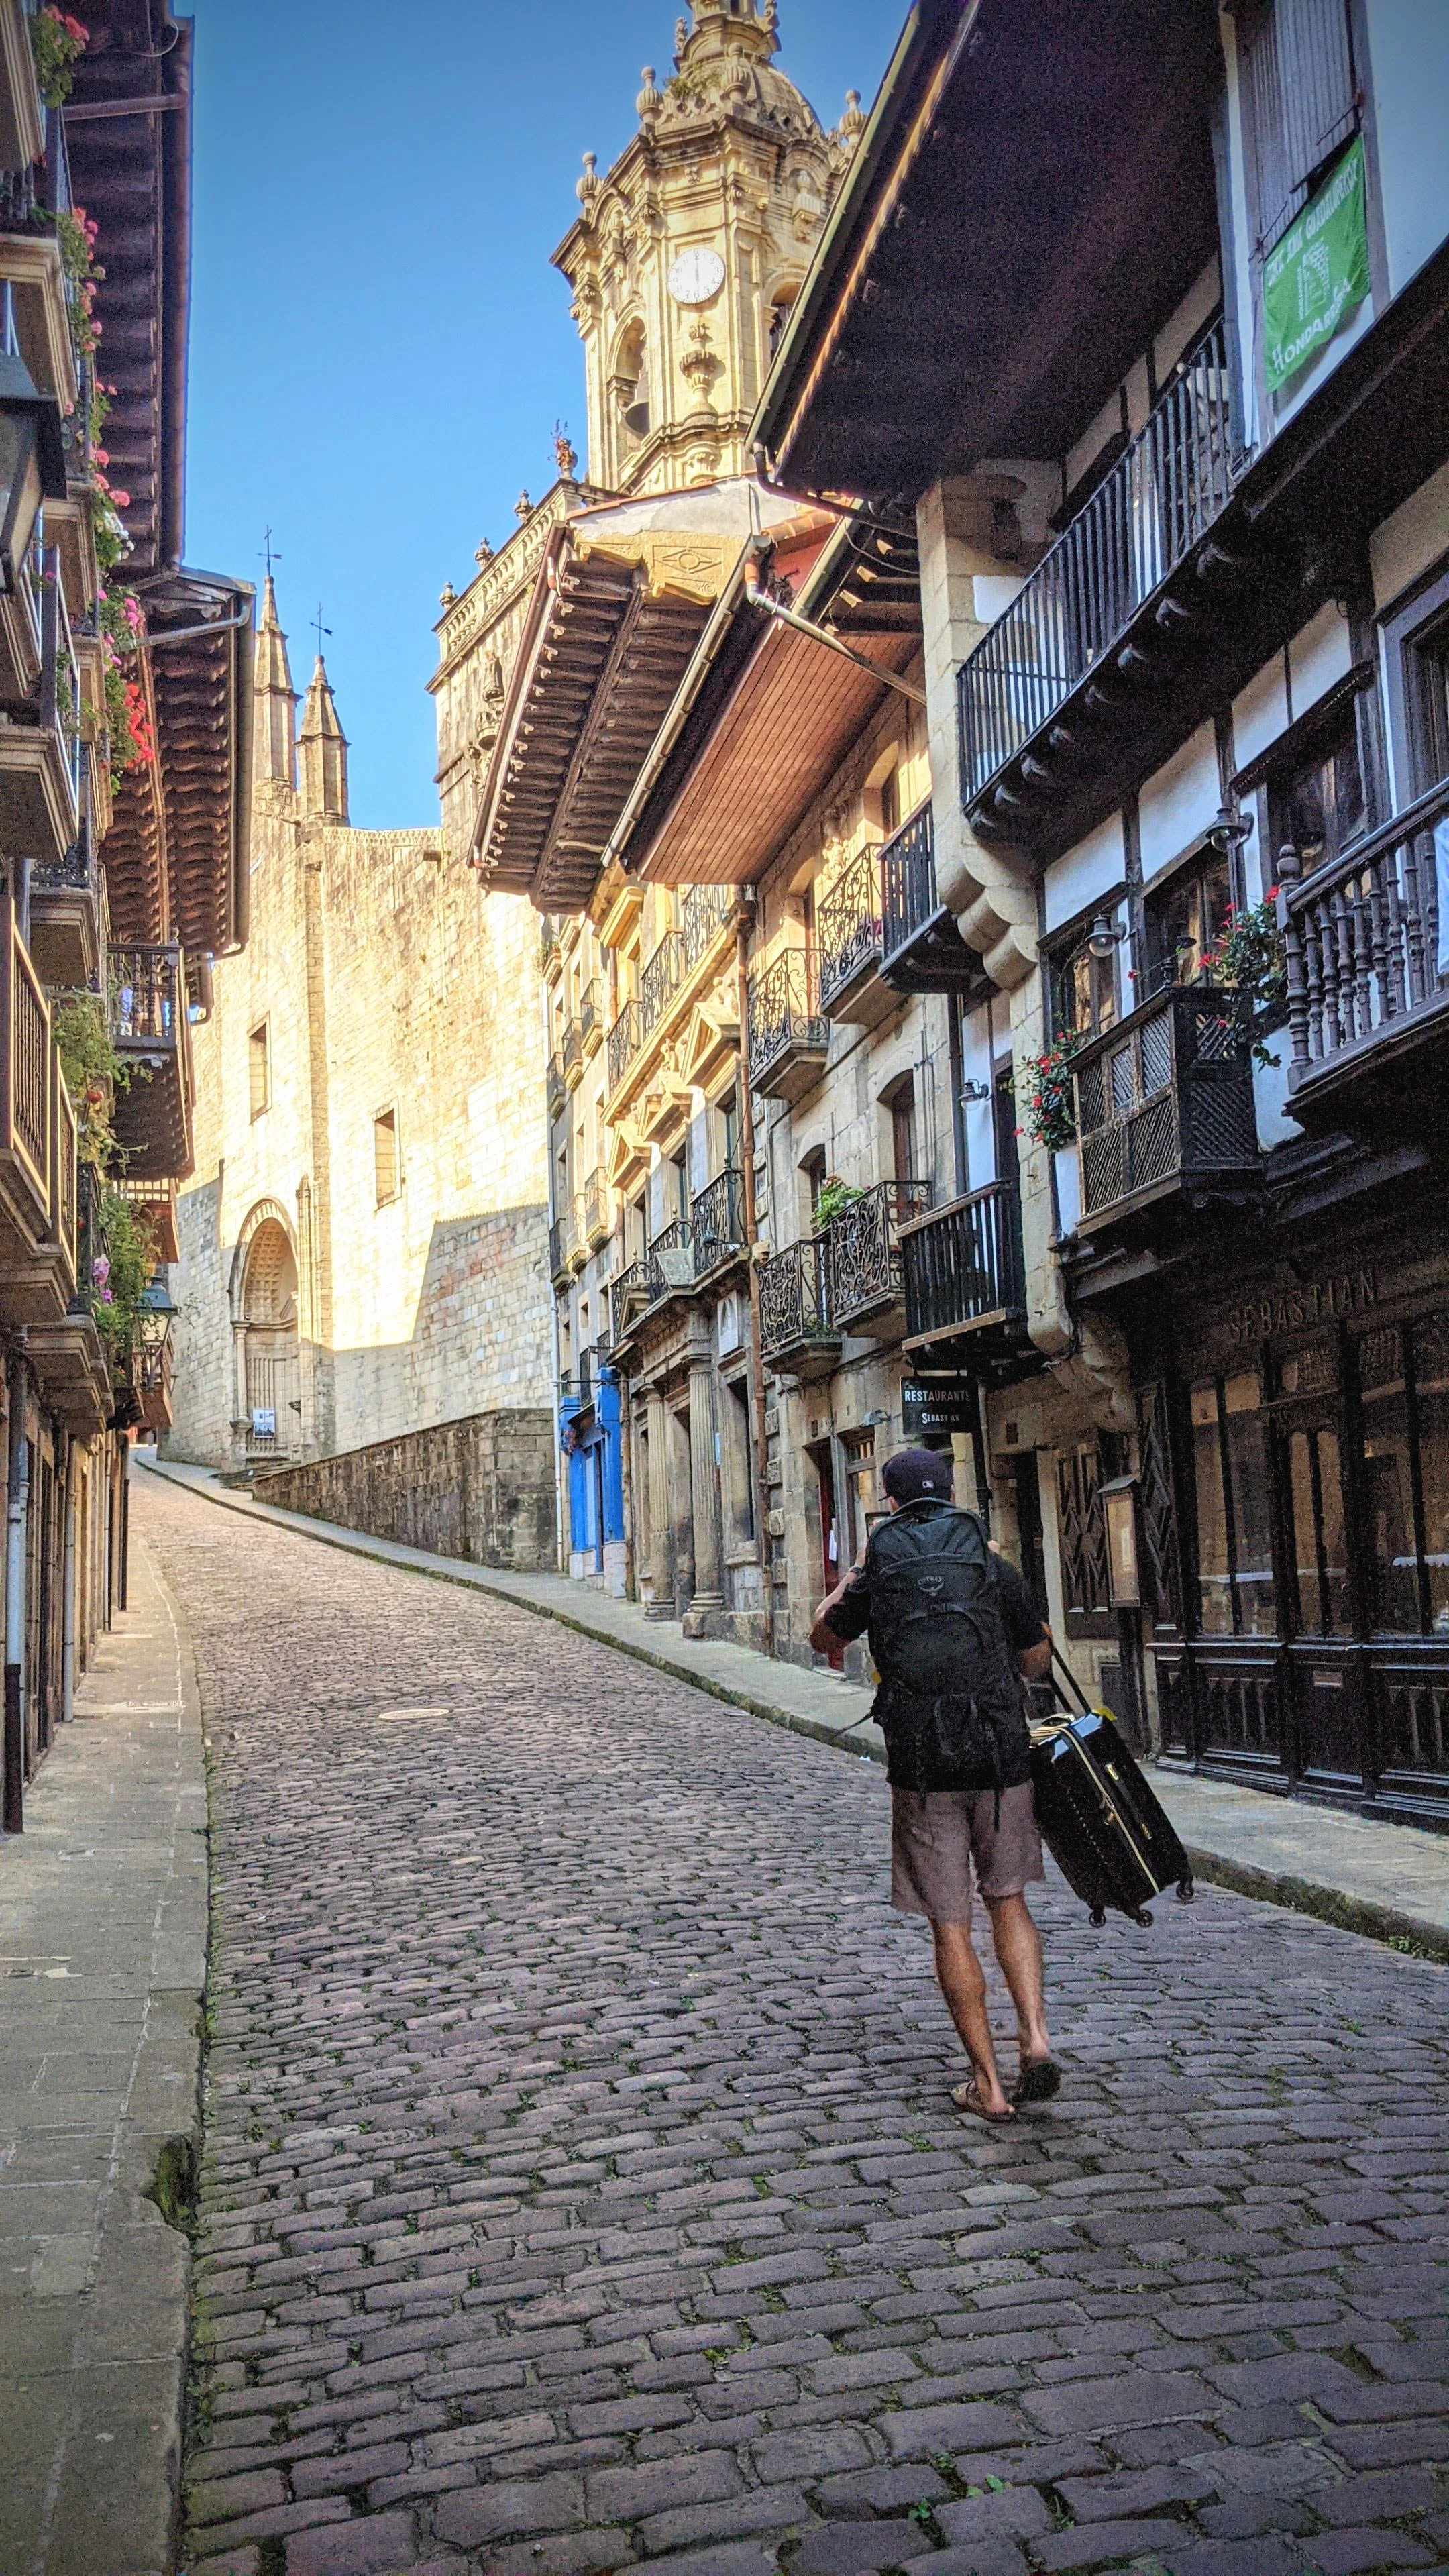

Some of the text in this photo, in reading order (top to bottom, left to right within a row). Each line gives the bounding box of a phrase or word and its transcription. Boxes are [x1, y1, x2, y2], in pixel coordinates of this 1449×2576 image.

[713, 267, 720, 275] 3
[1229, 1269, 1377, 1342] SEBASTIAN
[921, 1412, 961, 1424] SEBASTAN
